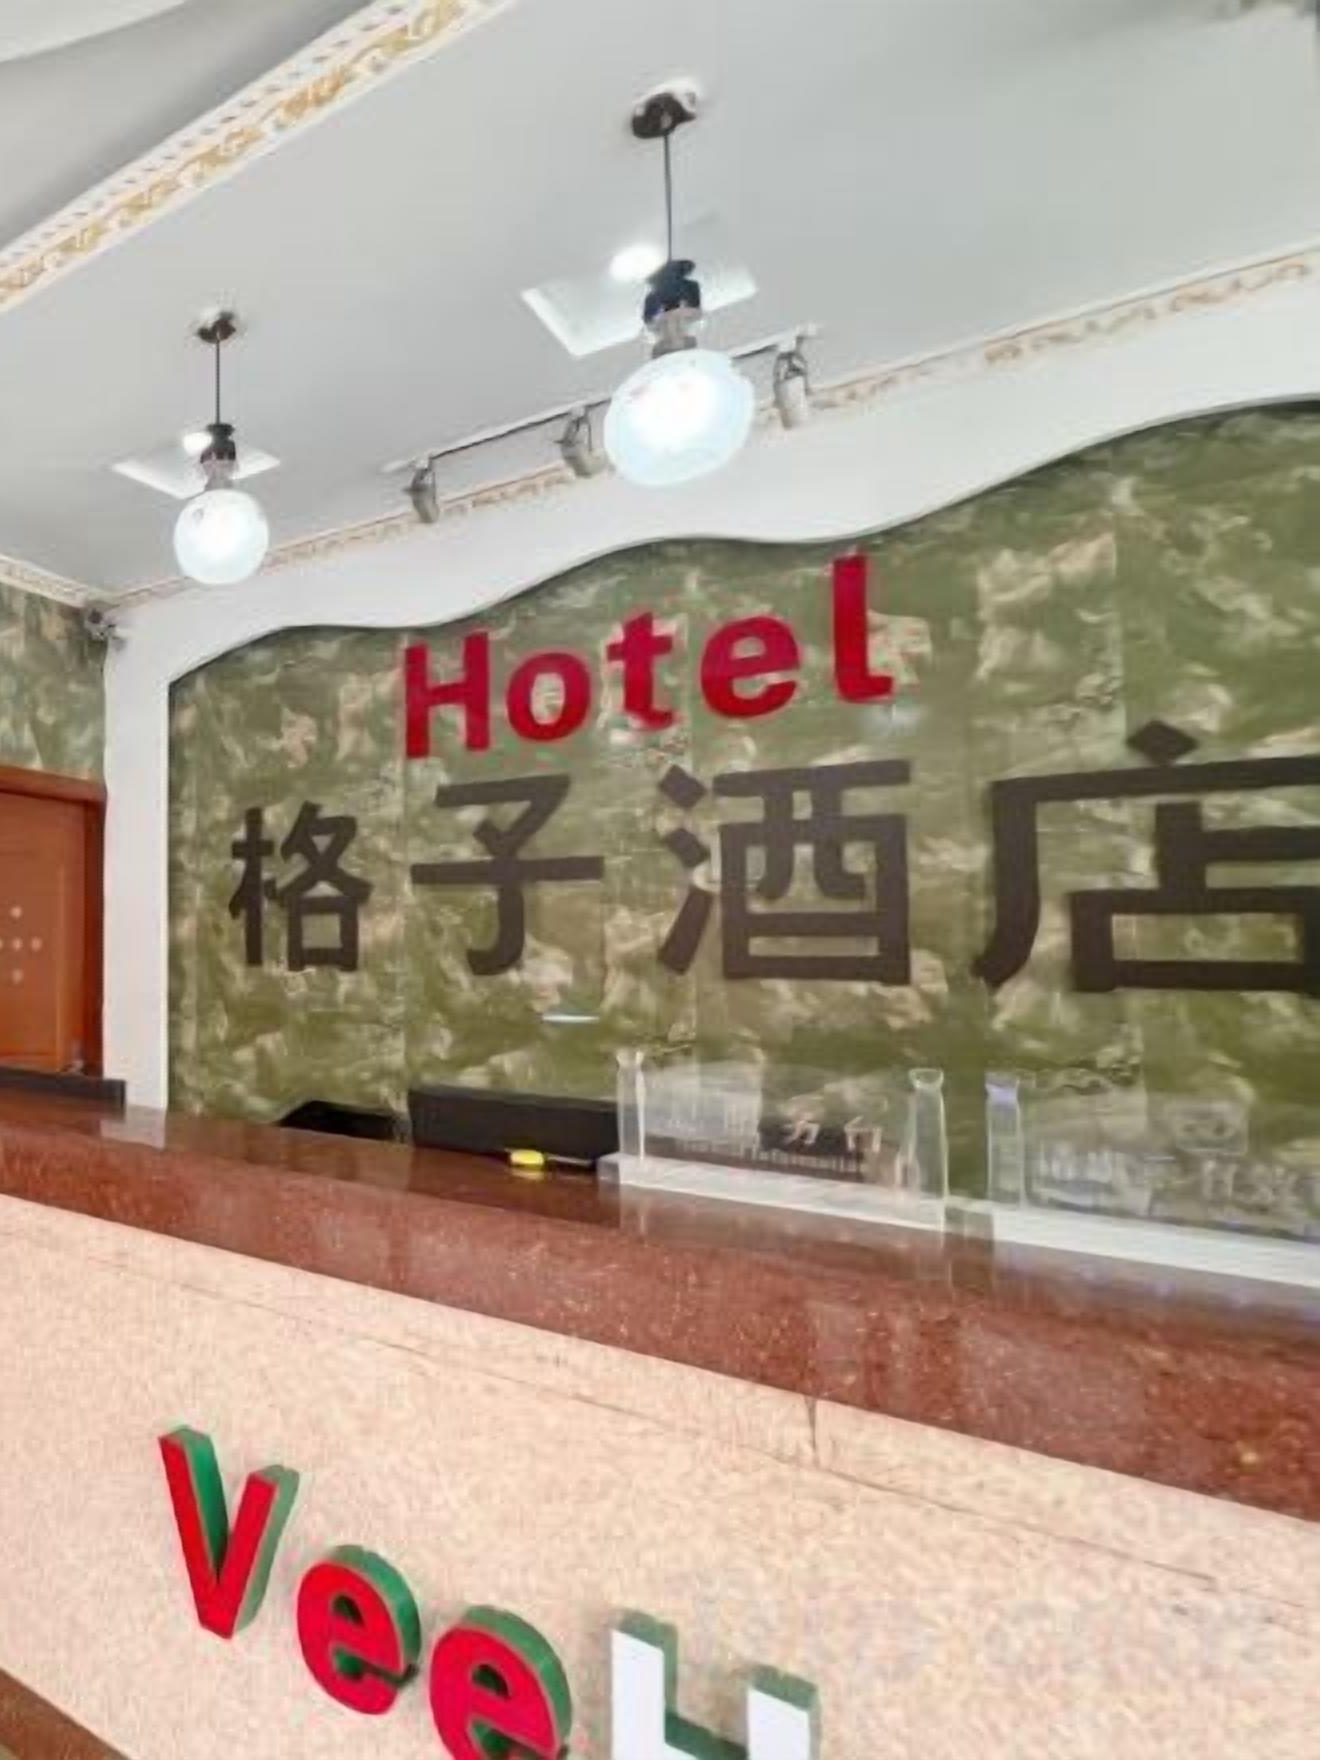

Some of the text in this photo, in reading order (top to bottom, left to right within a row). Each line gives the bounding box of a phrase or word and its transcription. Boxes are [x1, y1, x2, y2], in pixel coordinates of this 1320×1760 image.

[402, 553, 895, 758] Hotel
[228, 720, 1320, 993] 格子酒店
